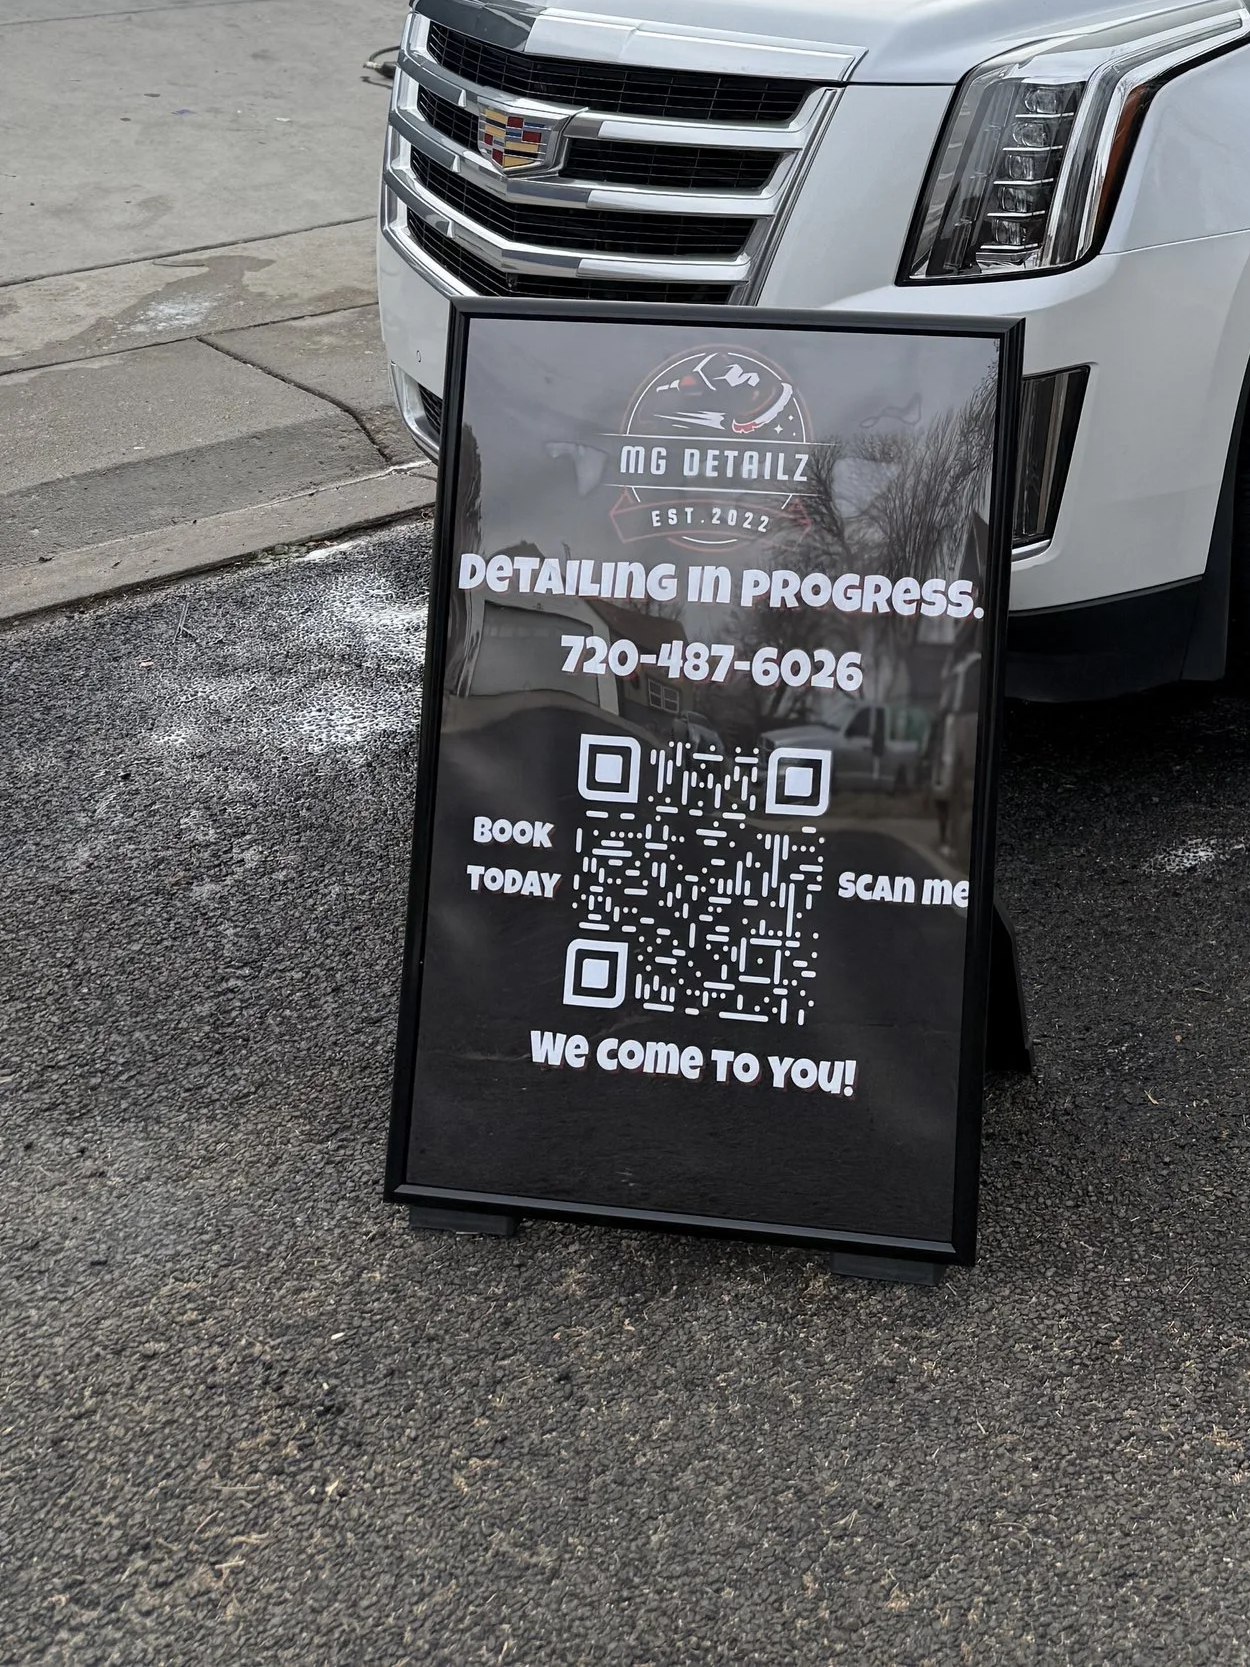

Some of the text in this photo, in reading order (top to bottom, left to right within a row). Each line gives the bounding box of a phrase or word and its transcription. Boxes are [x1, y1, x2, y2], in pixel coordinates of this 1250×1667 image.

[619, 445, 809, 483] MG DETAILZ
[560, 634, 864, 692] 720-487-6026
[473, 816, 554, 848] BOOK
[466, 864, 562, 898] TODAY
[530, 1030, 589, 1068] We
[596, 1037, 704, 1080] come
